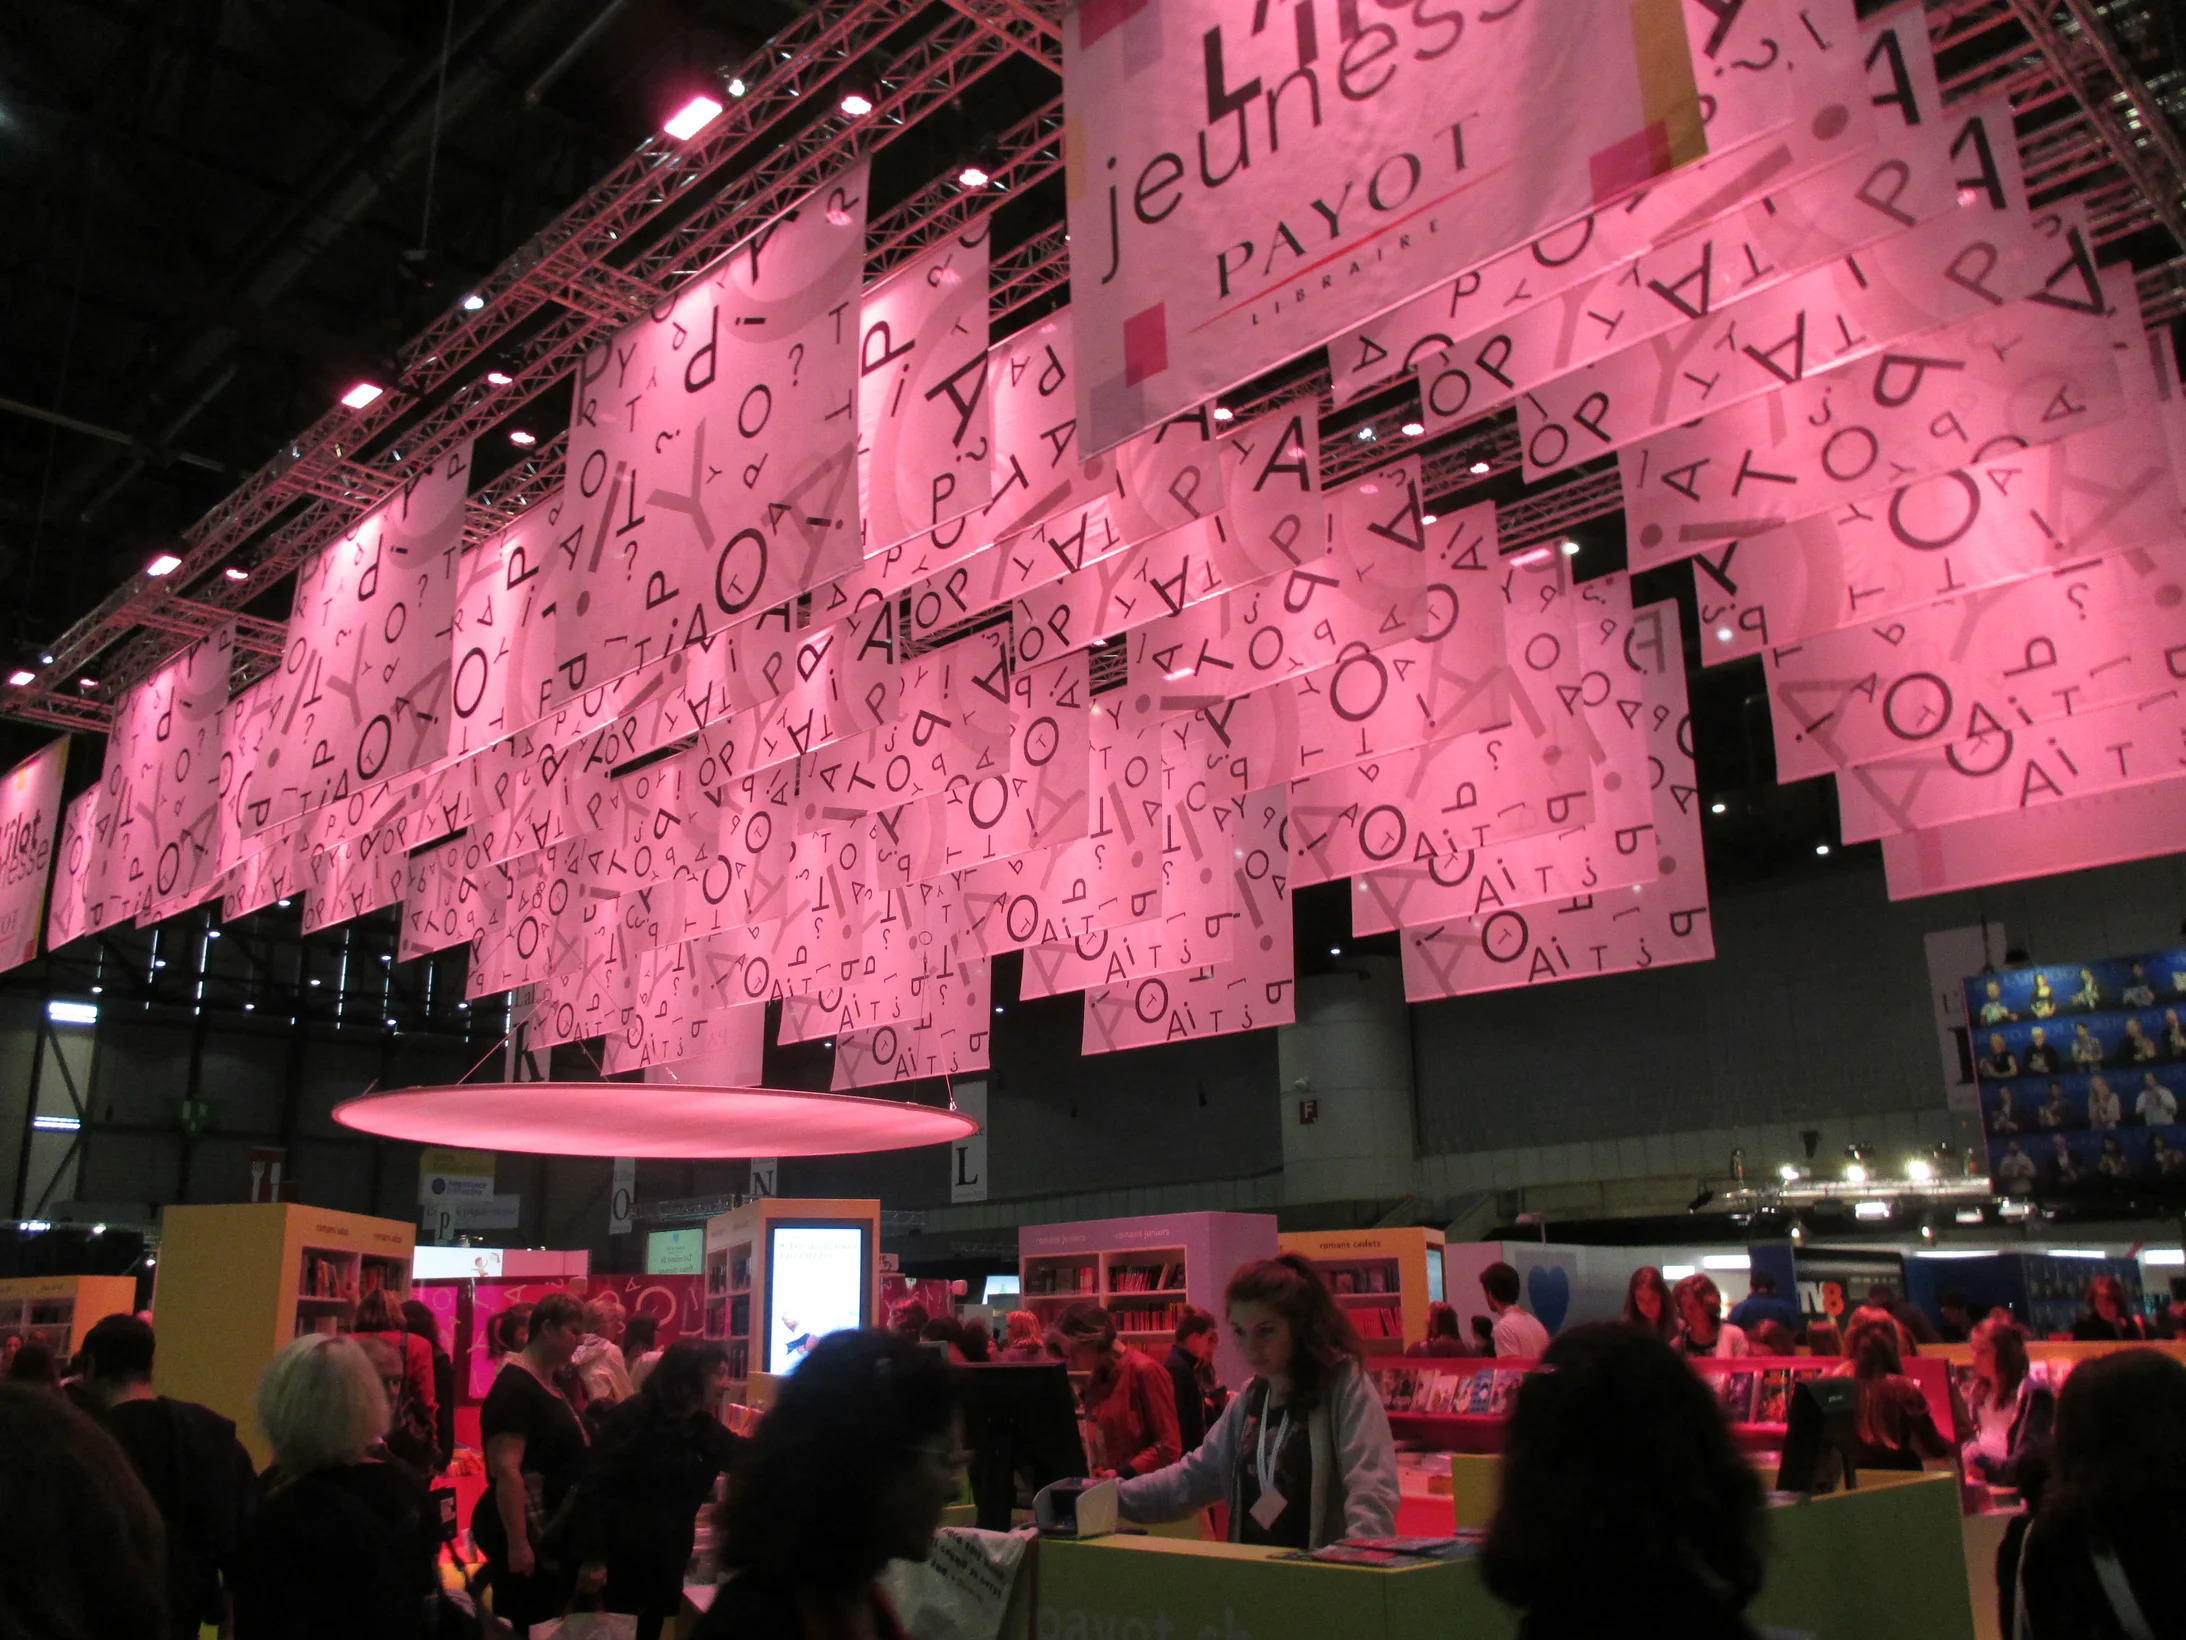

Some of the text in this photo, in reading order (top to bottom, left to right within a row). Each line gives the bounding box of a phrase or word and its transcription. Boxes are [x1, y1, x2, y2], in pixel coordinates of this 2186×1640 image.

[1218, 112, 1481, 299] PAYOT
[1251, 218, 1438, 326] LIBRAIRE
[955, 1146, 979, 1187] L
[752, 1170, 775, 1196] N
[613, 1188, 630, 1221] O
[438, 1211, 451, 1240] P
[1115, 1230, 1142, 1240] romans
[1319, 1239, 1382, 1249] romans cadets
